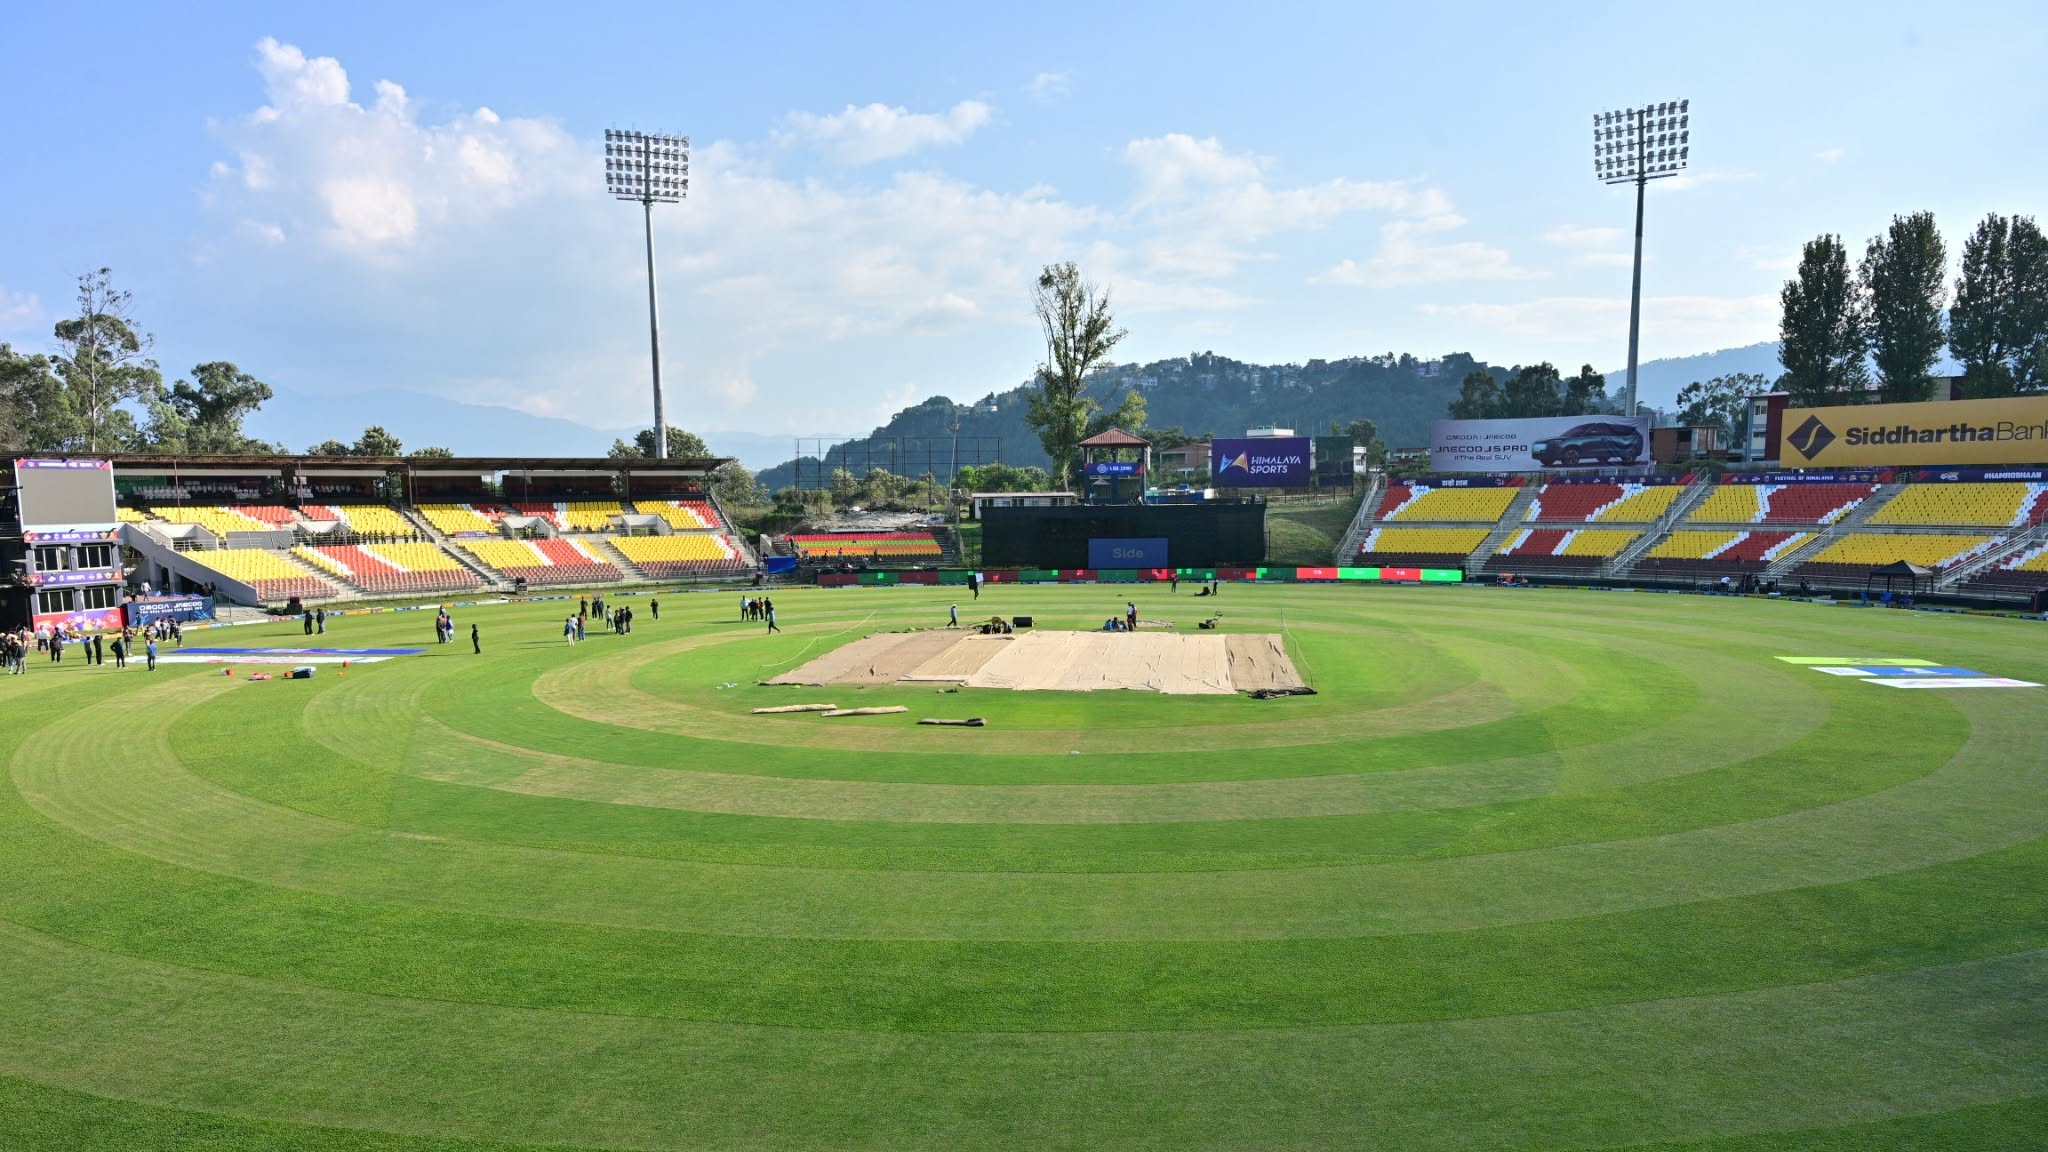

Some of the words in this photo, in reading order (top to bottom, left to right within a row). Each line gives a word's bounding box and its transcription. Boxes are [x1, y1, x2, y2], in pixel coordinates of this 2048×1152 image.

[1436, 445, 1483, 453] JAECOO
[1503, 444, 1528, 453] PRO
[1251, 455, 1301, 465] HIMALAYA
[1250, 465, 1288, 474] SPORTS
[1113, 547, 1143, 559] Side
